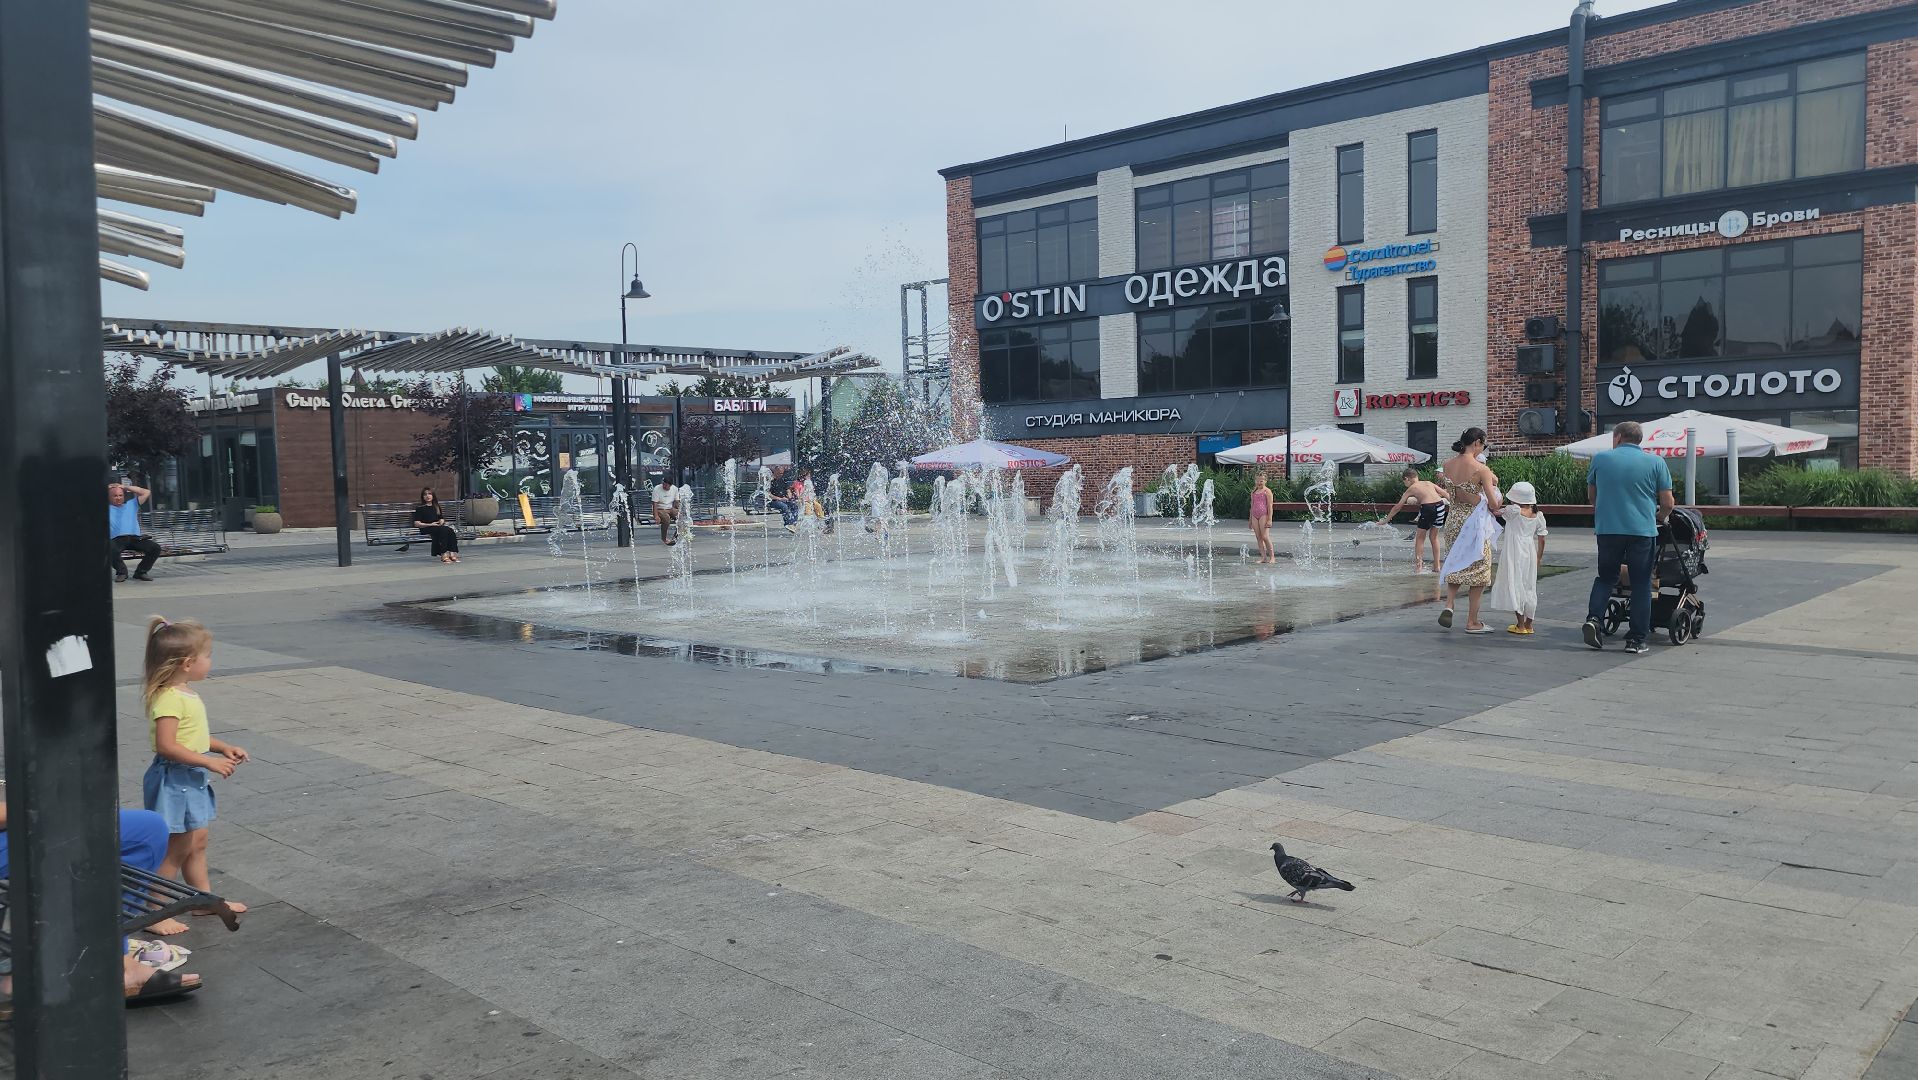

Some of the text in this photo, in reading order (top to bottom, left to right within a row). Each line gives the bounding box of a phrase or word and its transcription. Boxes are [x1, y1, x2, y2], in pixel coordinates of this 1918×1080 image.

[1620, 221, 1716, 243] Ресницы
[1753, 208, 1820, 227] Брови
[1124, 256, 1286, 307] одежда
[982, 284, 1086, 322] O'STIN
[1658, 368, 1842, 399] СТОЛОТО
[1365, 391, 1471, 409] ROSTIC'S
[1025, 407, 1182, 428] СТУДИЯ МАНИКЮРА
[1256, 453, 1322, 463] ROSIC'S
